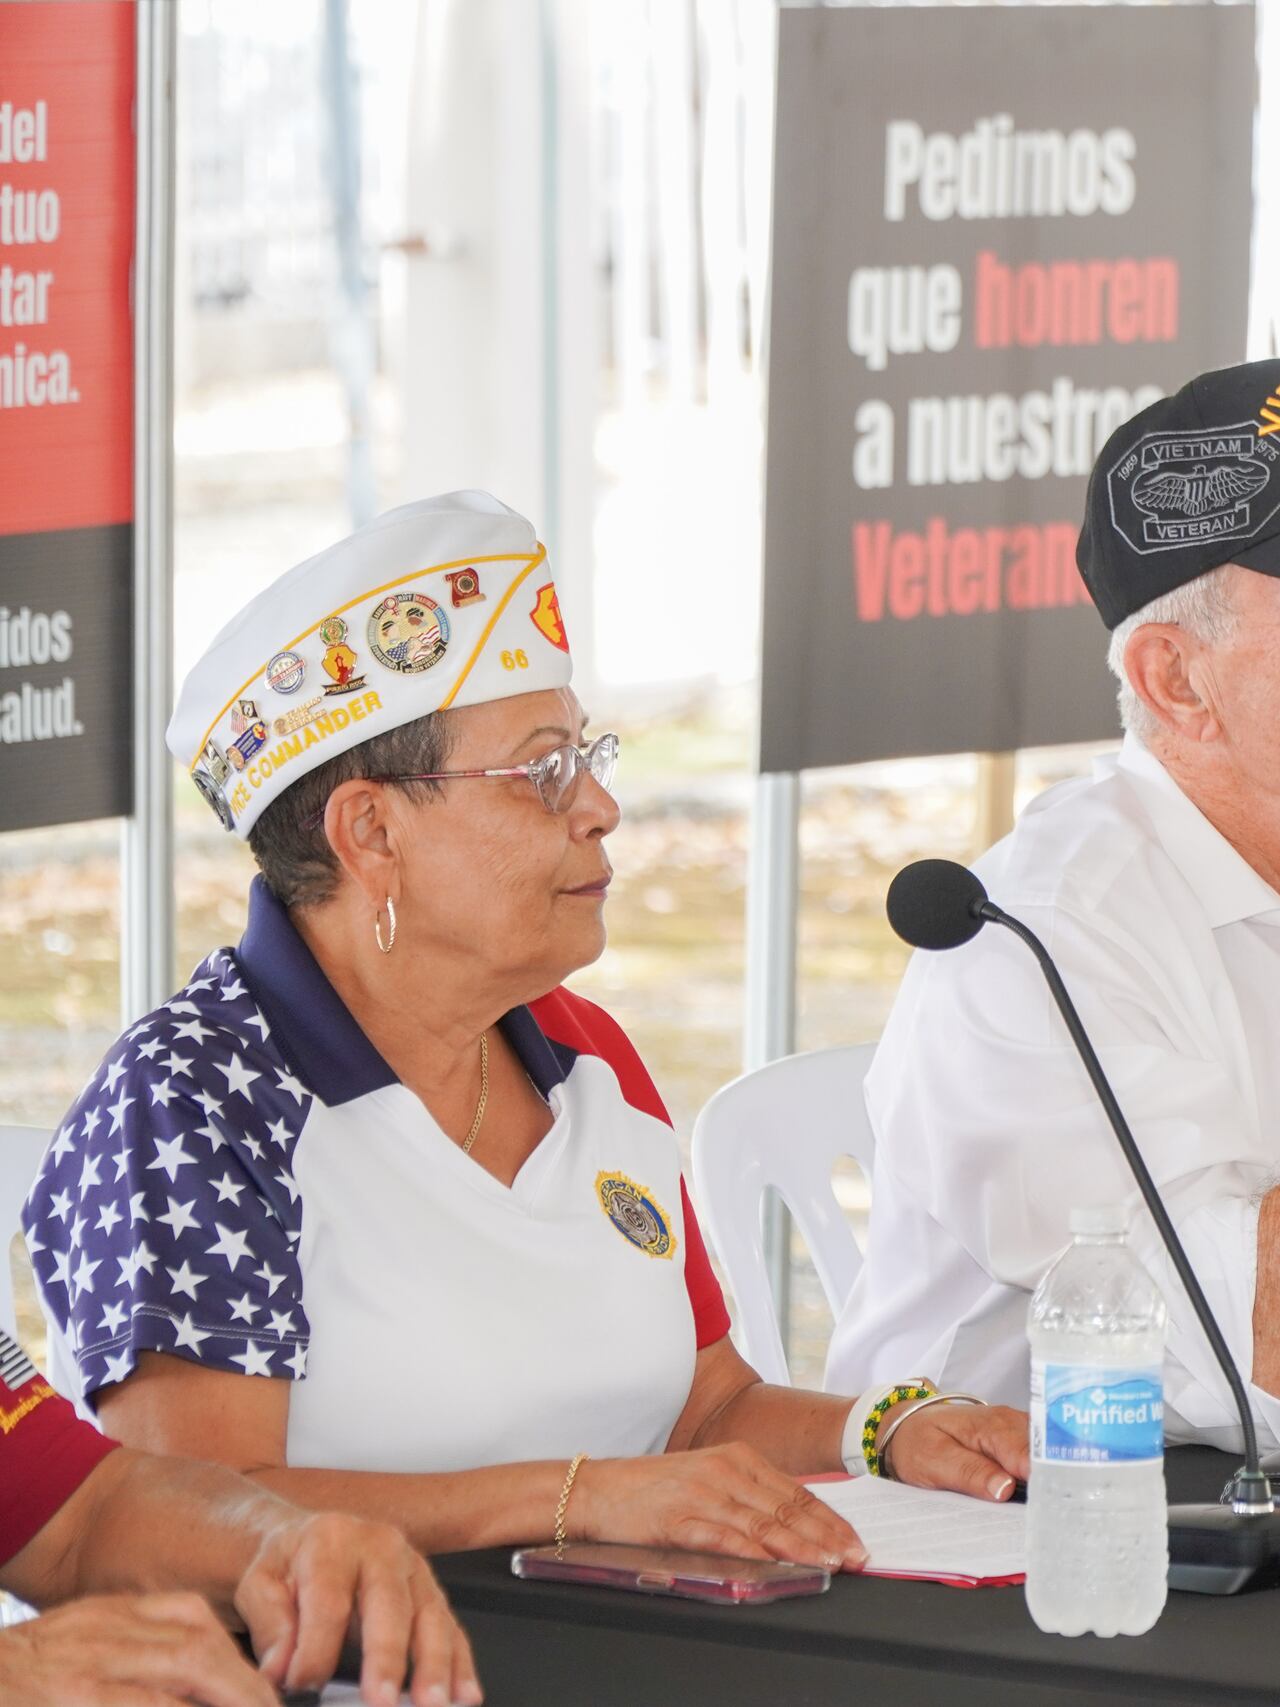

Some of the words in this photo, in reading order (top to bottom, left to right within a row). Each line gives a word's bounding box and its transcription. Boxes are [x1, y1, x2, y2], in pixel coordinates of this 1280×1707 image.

[884, 112, 1137, 221] Pedimos
[848, 263, 962, 371] que
[974, 250, 1179, 349] honren
[853, 399, 894, 489] a
[1152, 439, 1242, 460] VIETNAM
[1255, 438, 1280, 462] 1975
[1156, 514, 1236, 539] VETERAN
[853, 515, 1096, 622] Veteran
[500, 648, 529, 671] 66
[247, 691, 383, 789] COMMANDER
[1062, 1403, 1148, 1425] Purified
